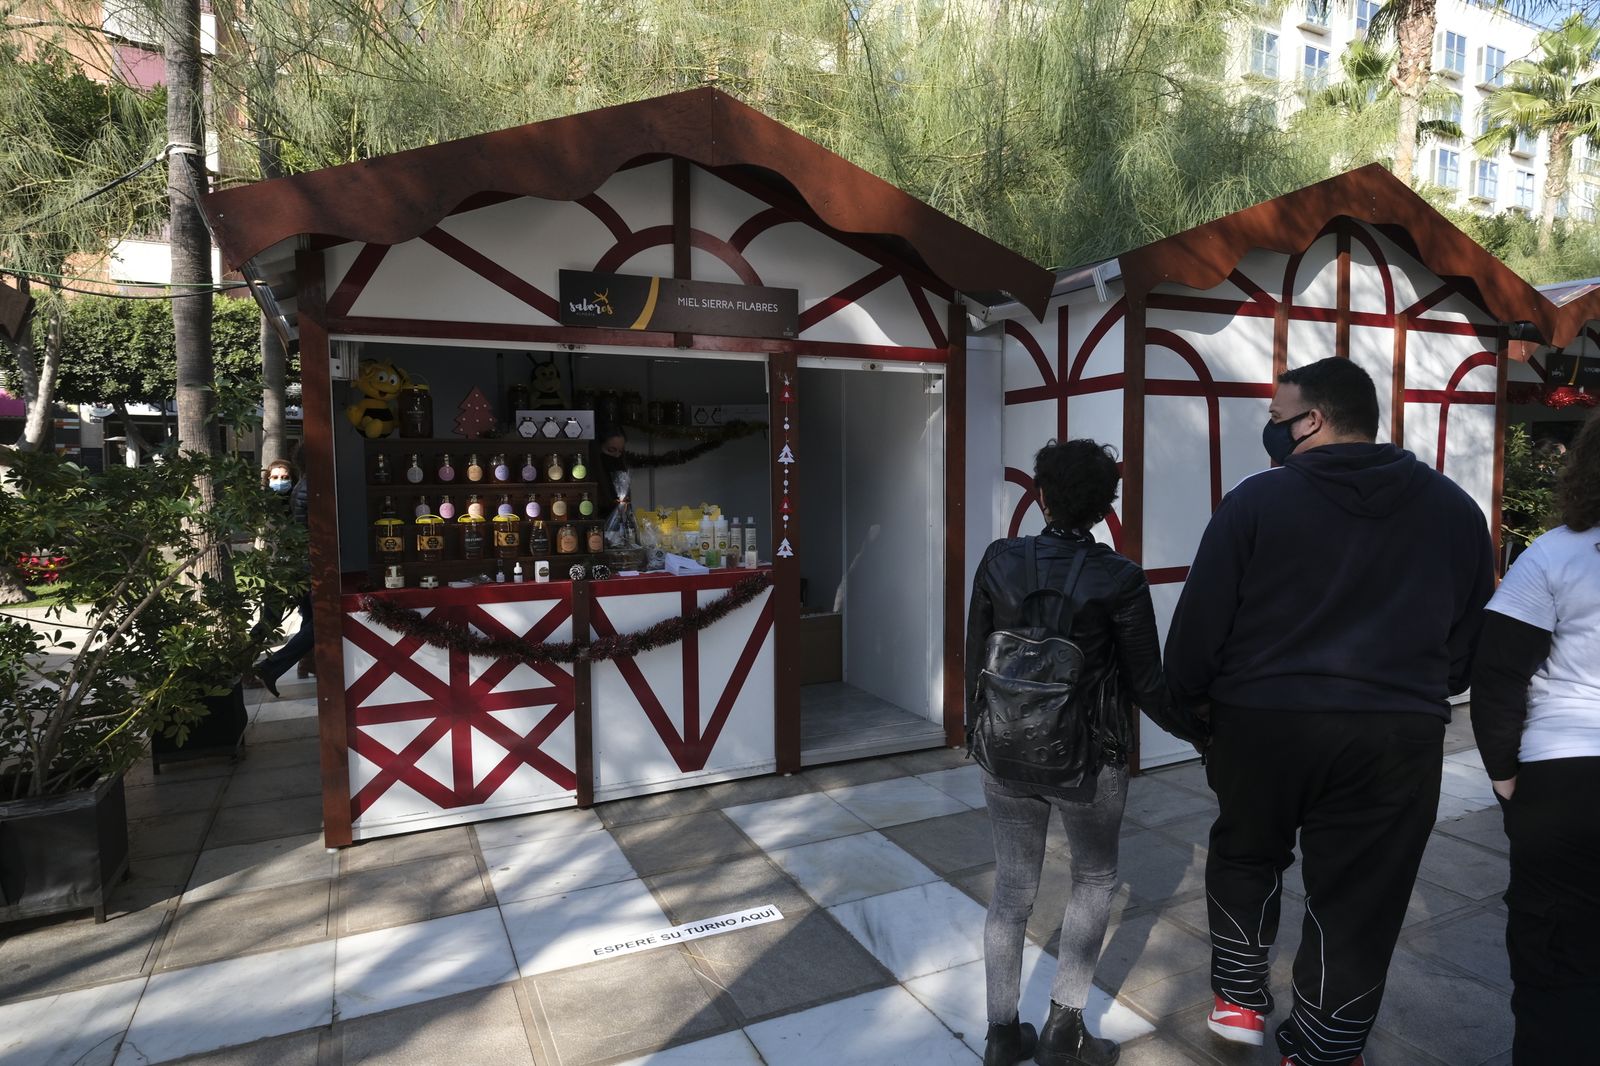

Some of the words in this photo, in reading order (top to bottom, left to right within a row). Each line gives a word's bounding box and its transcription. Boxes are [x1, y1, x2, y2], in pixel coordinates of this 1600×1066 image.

[677, 297, 699, 308] MIEL
[701, 299, 735, 310] SIERRA
[736, 301, 779, 313] FILABRES
[593, 937, 657, 956] ESPERE
[660, 931, 681, 942] SU
[684, 918, 737, 935] TURNO
